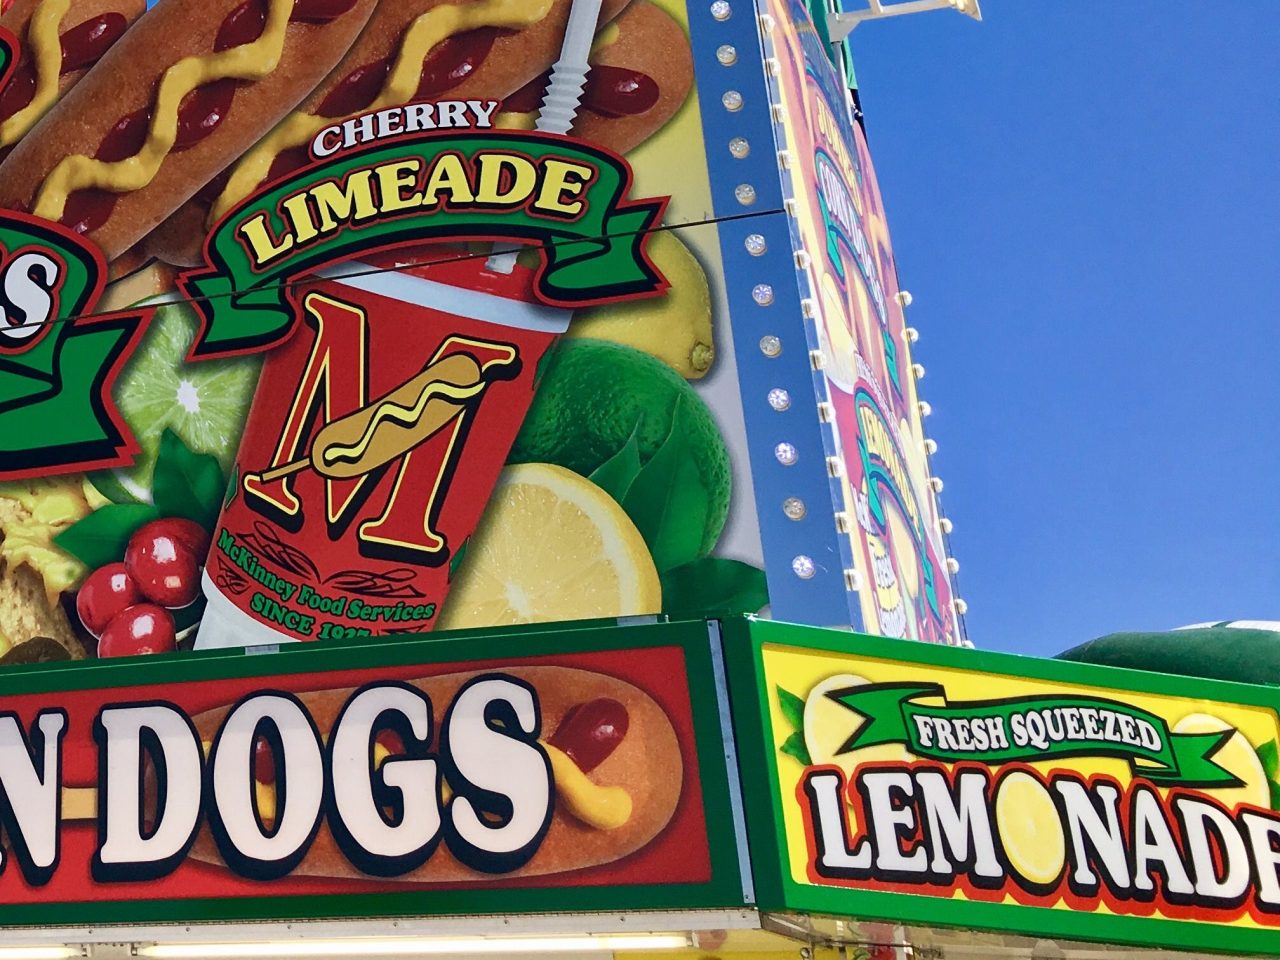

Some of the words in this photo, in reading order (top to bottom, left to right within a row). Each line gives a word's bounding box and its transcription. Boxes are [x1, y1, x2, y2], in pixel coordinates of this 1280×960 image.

[312, 100, 499, 158] CHERRY
[241, 154, 593, 266] LIMEADE
[243, 293, 520, 558] M
[218, 528, 298, 601] McKinney
[297, 584, 347, 616] Food
[346, 599, 436, 622] Services
[250, 593, 315, 636] SINCE
[98, 677, 552, 870] DOGS
[913, 713, 1008, 751] FRESH
[1012, 706, 1163, 751] SQUEEZED
